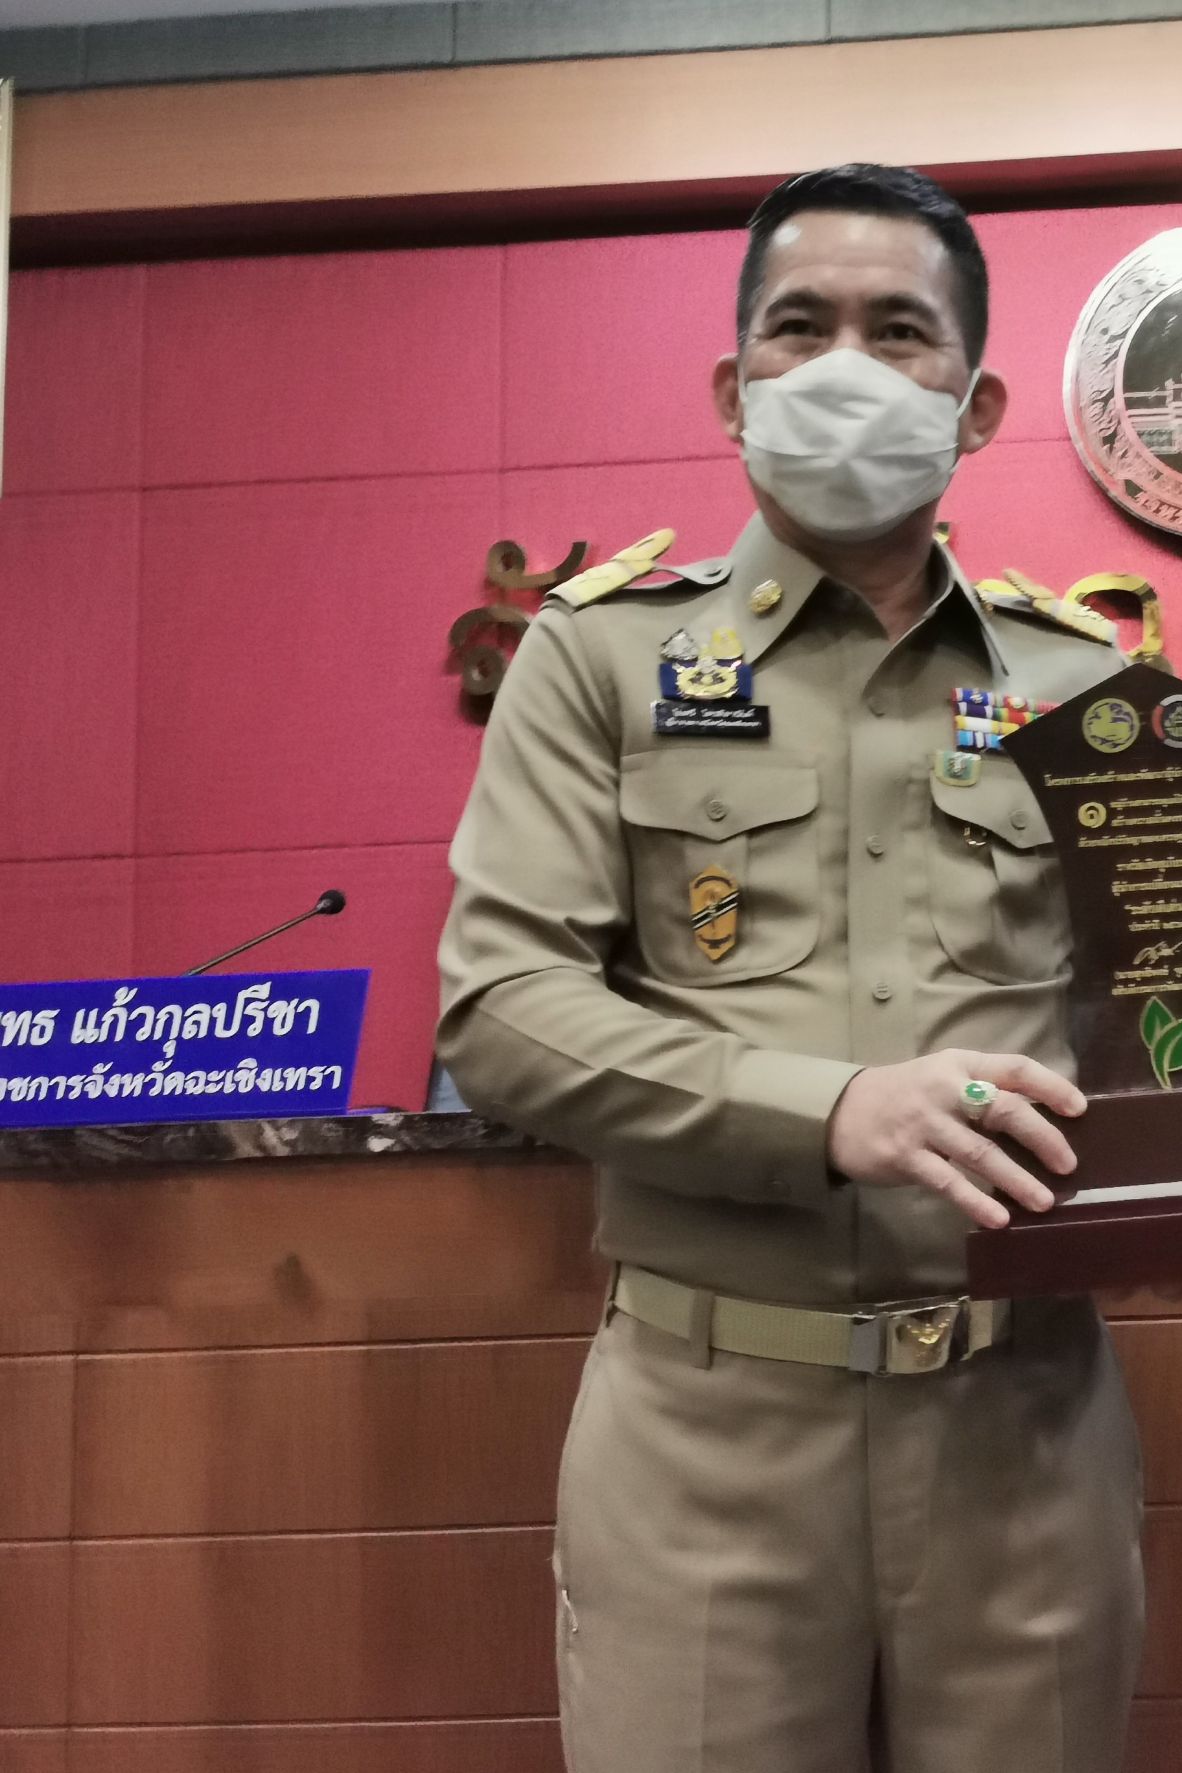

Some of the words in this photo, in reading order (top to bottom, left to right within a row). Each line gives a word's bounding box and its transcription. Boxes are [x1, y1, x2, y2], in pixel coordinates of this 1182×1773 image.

[0, 1009, 60, 1047] ทธ
[70, 981, 320, 1059] แก้วกุลปรีชา
